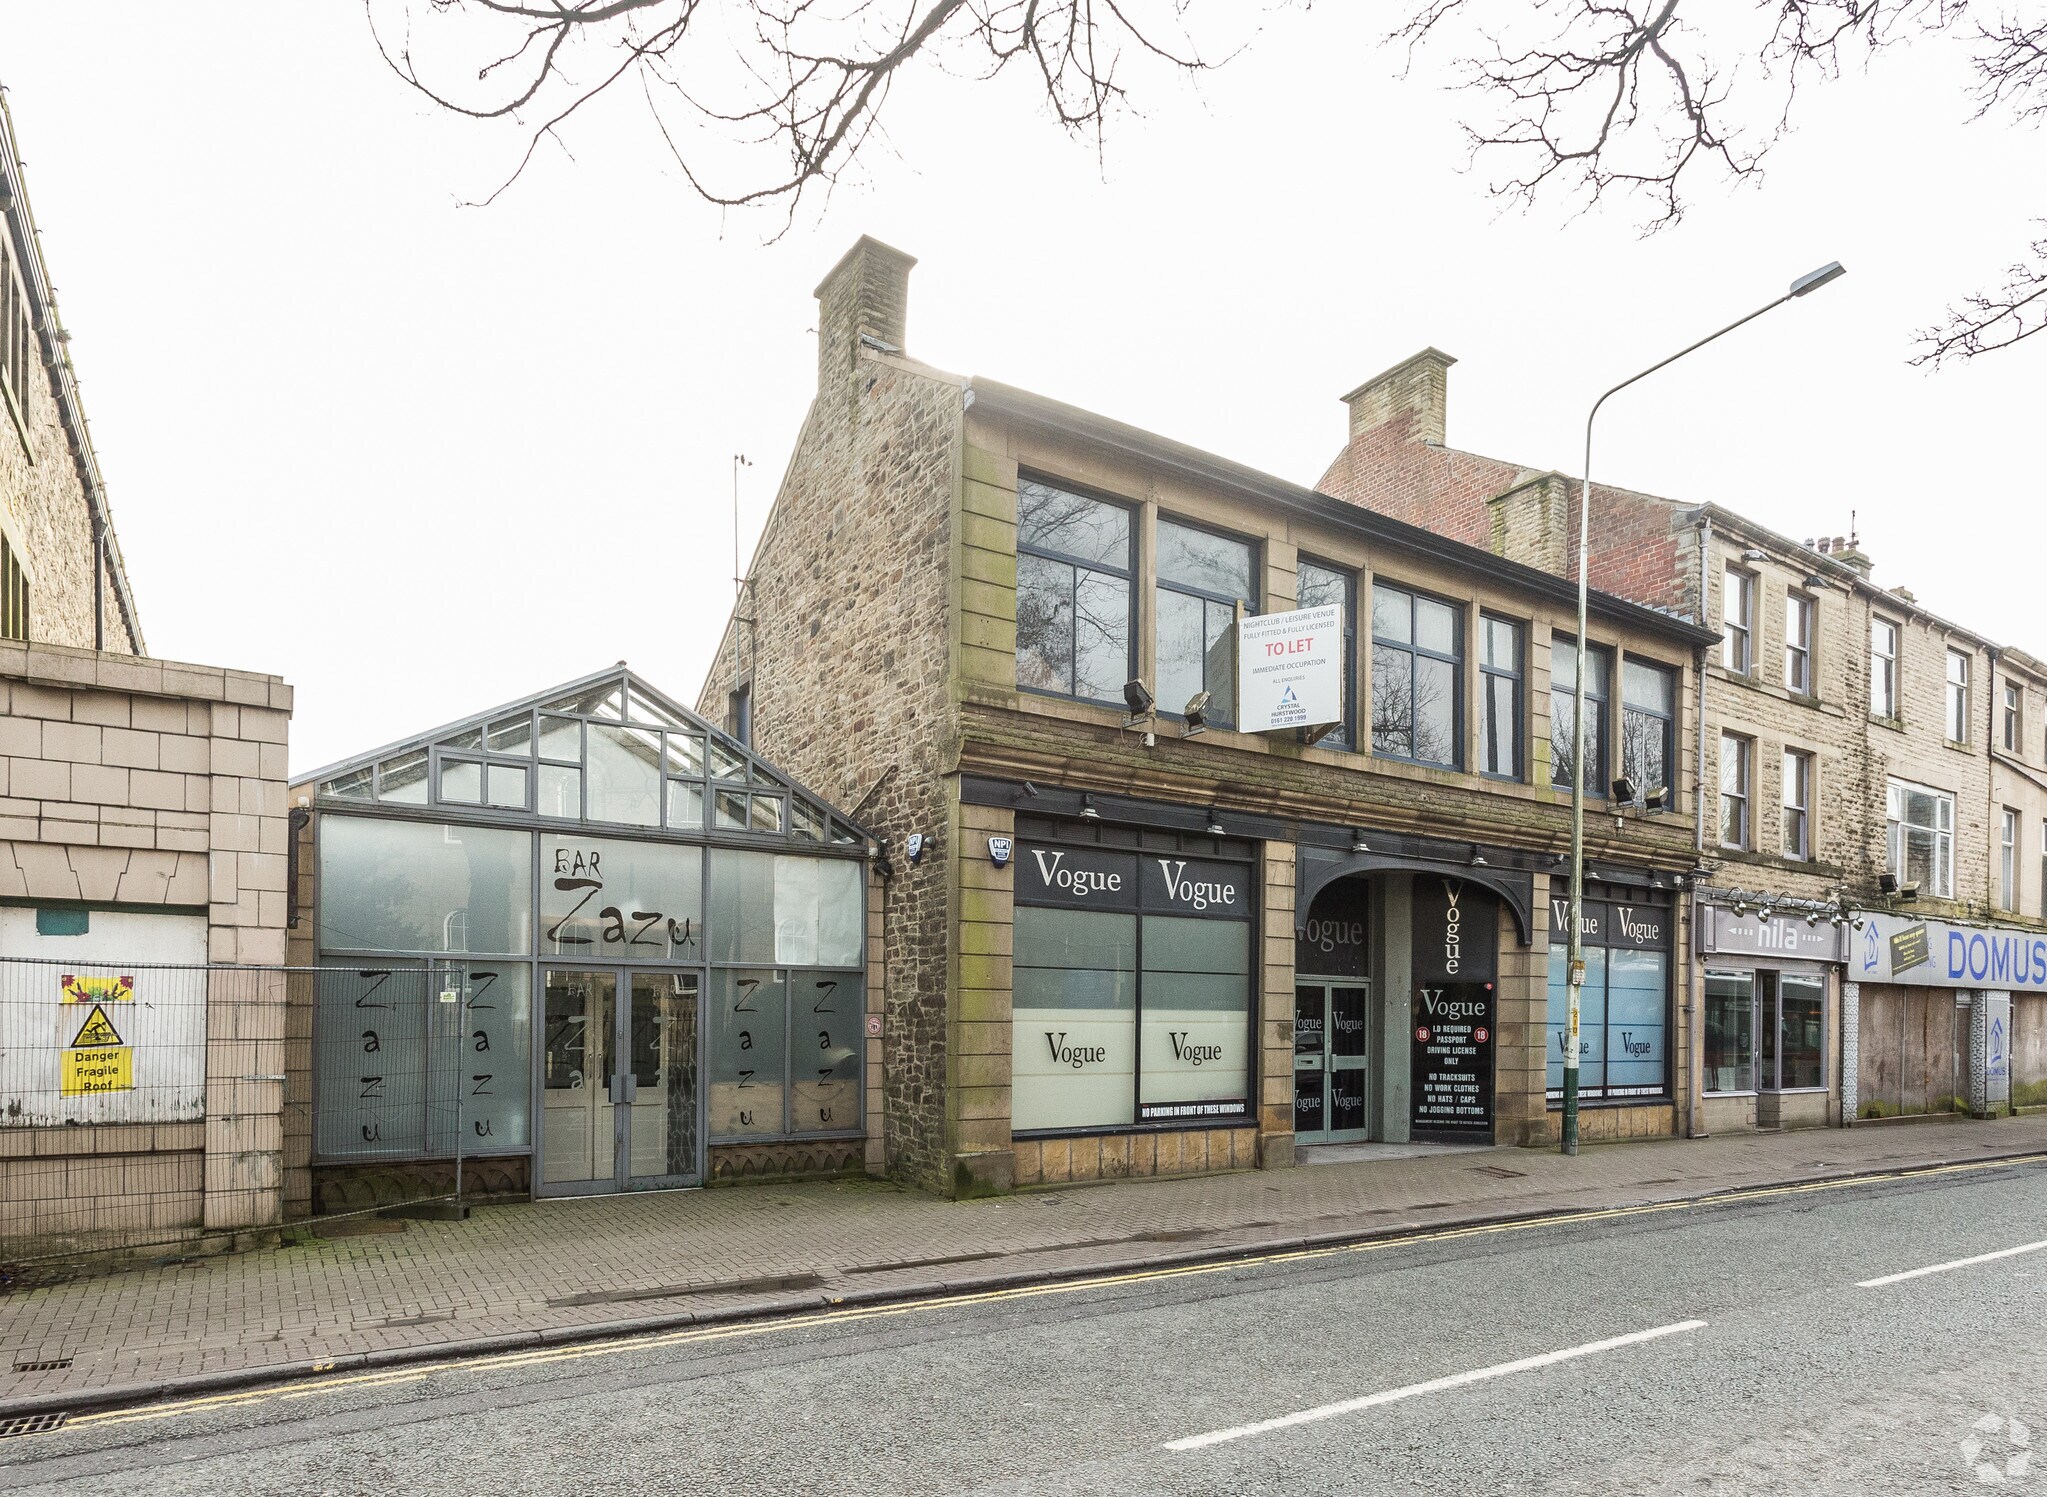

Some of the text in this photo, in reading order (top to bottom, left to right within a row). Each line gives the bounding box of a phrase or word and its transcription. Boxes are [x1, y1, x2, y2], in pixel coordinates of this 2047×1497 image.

[1243, 617, 1280, 630] NIGHTCLUB
[1285, 613, 1312, 624] LEISURE
[1312, 609, 1335, 619] VENUE
[1243, 620, 1335, 640] FULLY FITTED & FULLY LICENSED
[1265, 637, 1314, 657] TO LET
[1252, 658, 1326, 675] IMMEDIATE OCCUPATION
[1281, 674, 1306, 683] ENQUIRIES
[1270, 708, 1307, 718] HURSTWOOD
[1276, 702, 1301, 711] CRYSTAL
[994, 840, 1009, 849] NPI
[554, 848, 603, 879] BAR
[1031, 849, 1122, 896] Vogue
[1157, 859, 1236, 910] Vogue
[547, 877, 695, 946] Zazu
[1551, 899, 1598, 935] Vue
[1442, 878, 1464, 975] Vogue
[1617, 906, 1660, 944] Vogue
[1757, 919, 1798, 950] nila
[1298, 919, 1363, 952] ogue
[1948, 930, 2047, 985] DOMUS
[1420, 989, 1486, 1021] Vogue
[1332, 1011, 1364, 1034] Vogue
[1442, 1025, 1472, 1034] REQUIRED
[1419, 1030, 1428, 1039] 18
[1436, 1036, 1467, 1044] PASSPORT
[1477, 1030, 1486, 1040] 18
[1557, 1031, 1589, 1055] Vue
[1622, 1031, 1651, 1058] Vogue
[75, 1052, 119, 1062] Danger
[466, 972, 499, 1137] Zazu
[734, 979, 760, 1125] Zazu
[813, 981, 838, 1122] Zazu
[1044, 1032, 1106, 1069] Vogue
[1169, 1032, 1222, 1066] Vogue
[1427, 1046, 1477, 1055] DRIVING LICENSE
[1444, 1057, 1459, 1065] ONLY
[77, 1065, 119, 1078] Fragile
[1428, 1073, 1476, 1082] NO TRACKSUITS
[83, 1080, 113, 1091] Roof
[1424, 1084, 1480, 1093] NO WORK CLOTHES
[1331, 1088, 1363, 1111] Vogue
[1427, 1094, 1436, 1103] NO
[1437, 1095, 1453, 1103] HATS
[1460, 1095, 1476, 1104] CAPS
[1141, 1103, 1245, 1118] NO PARKING IN FRONT OF THESE WINDOWS
[1419, 1105, 1484, 1115] NO JOGGING BOTTOMS
